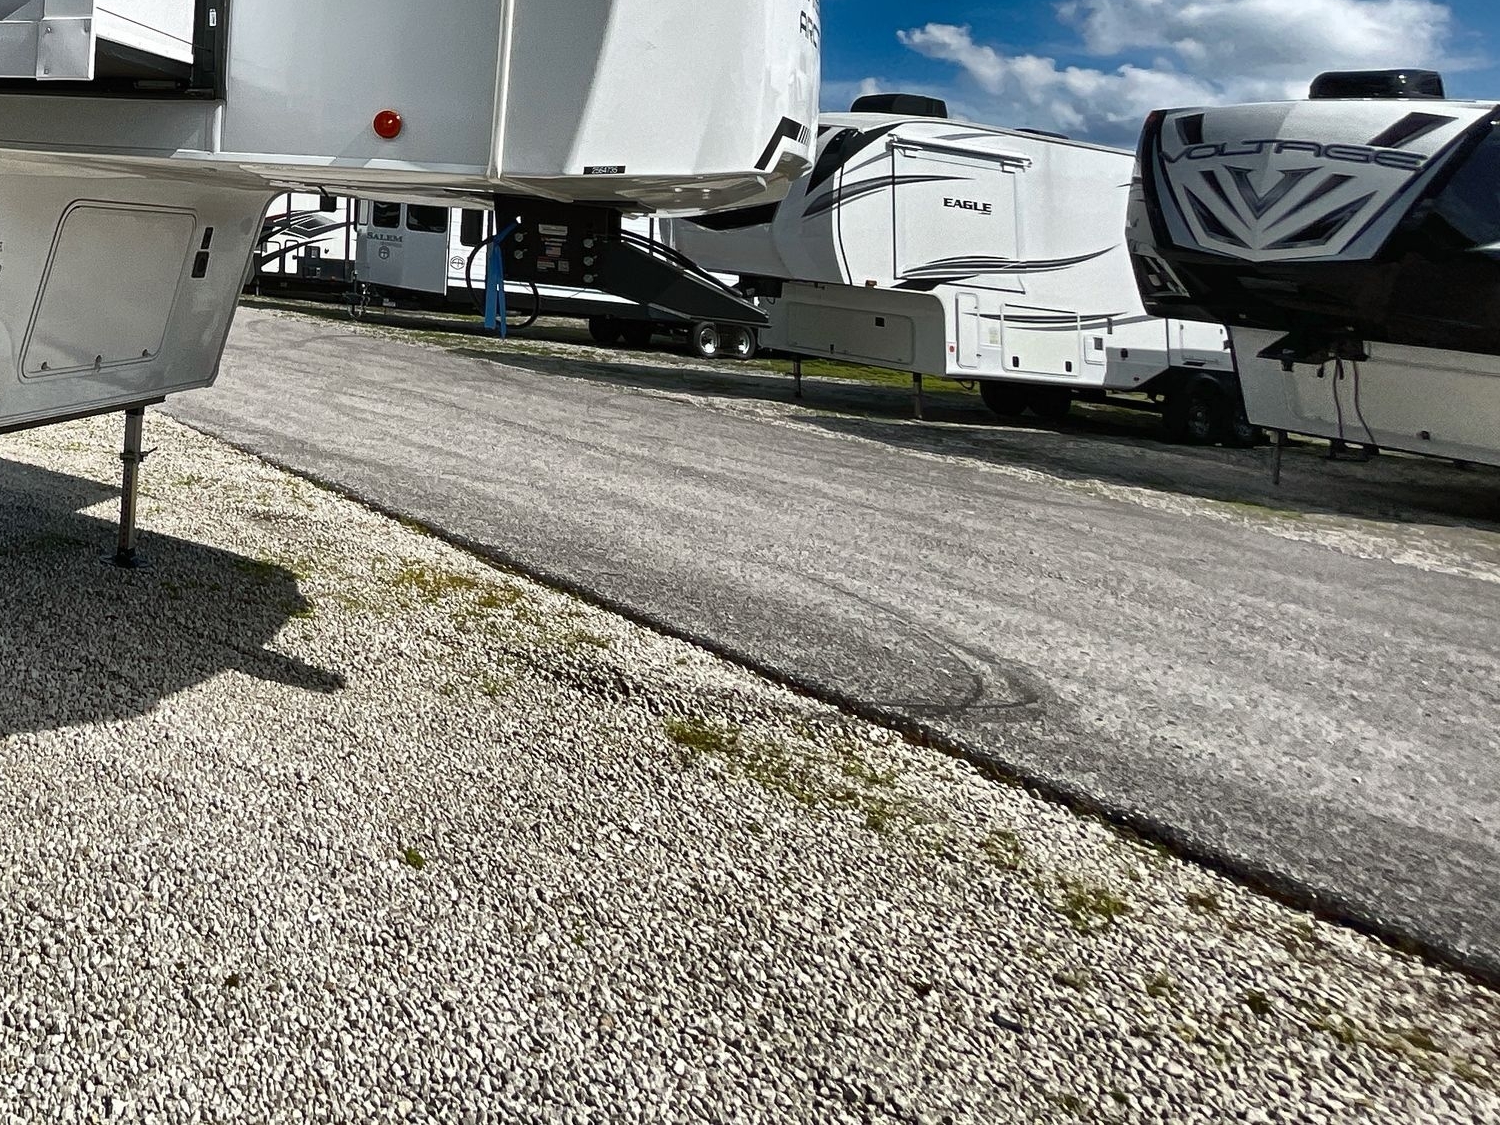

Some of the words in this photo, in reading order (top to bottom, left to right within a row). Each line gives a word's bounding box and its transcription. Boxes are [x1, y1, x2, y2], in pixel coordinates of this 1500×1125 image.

[800, 10, 821, 49] ARC
[1159, 139, 1429, 172] VOLTAGE
[943, 197, 992, 213] EAGLE
[366, 232, 403, 243] SALEM
